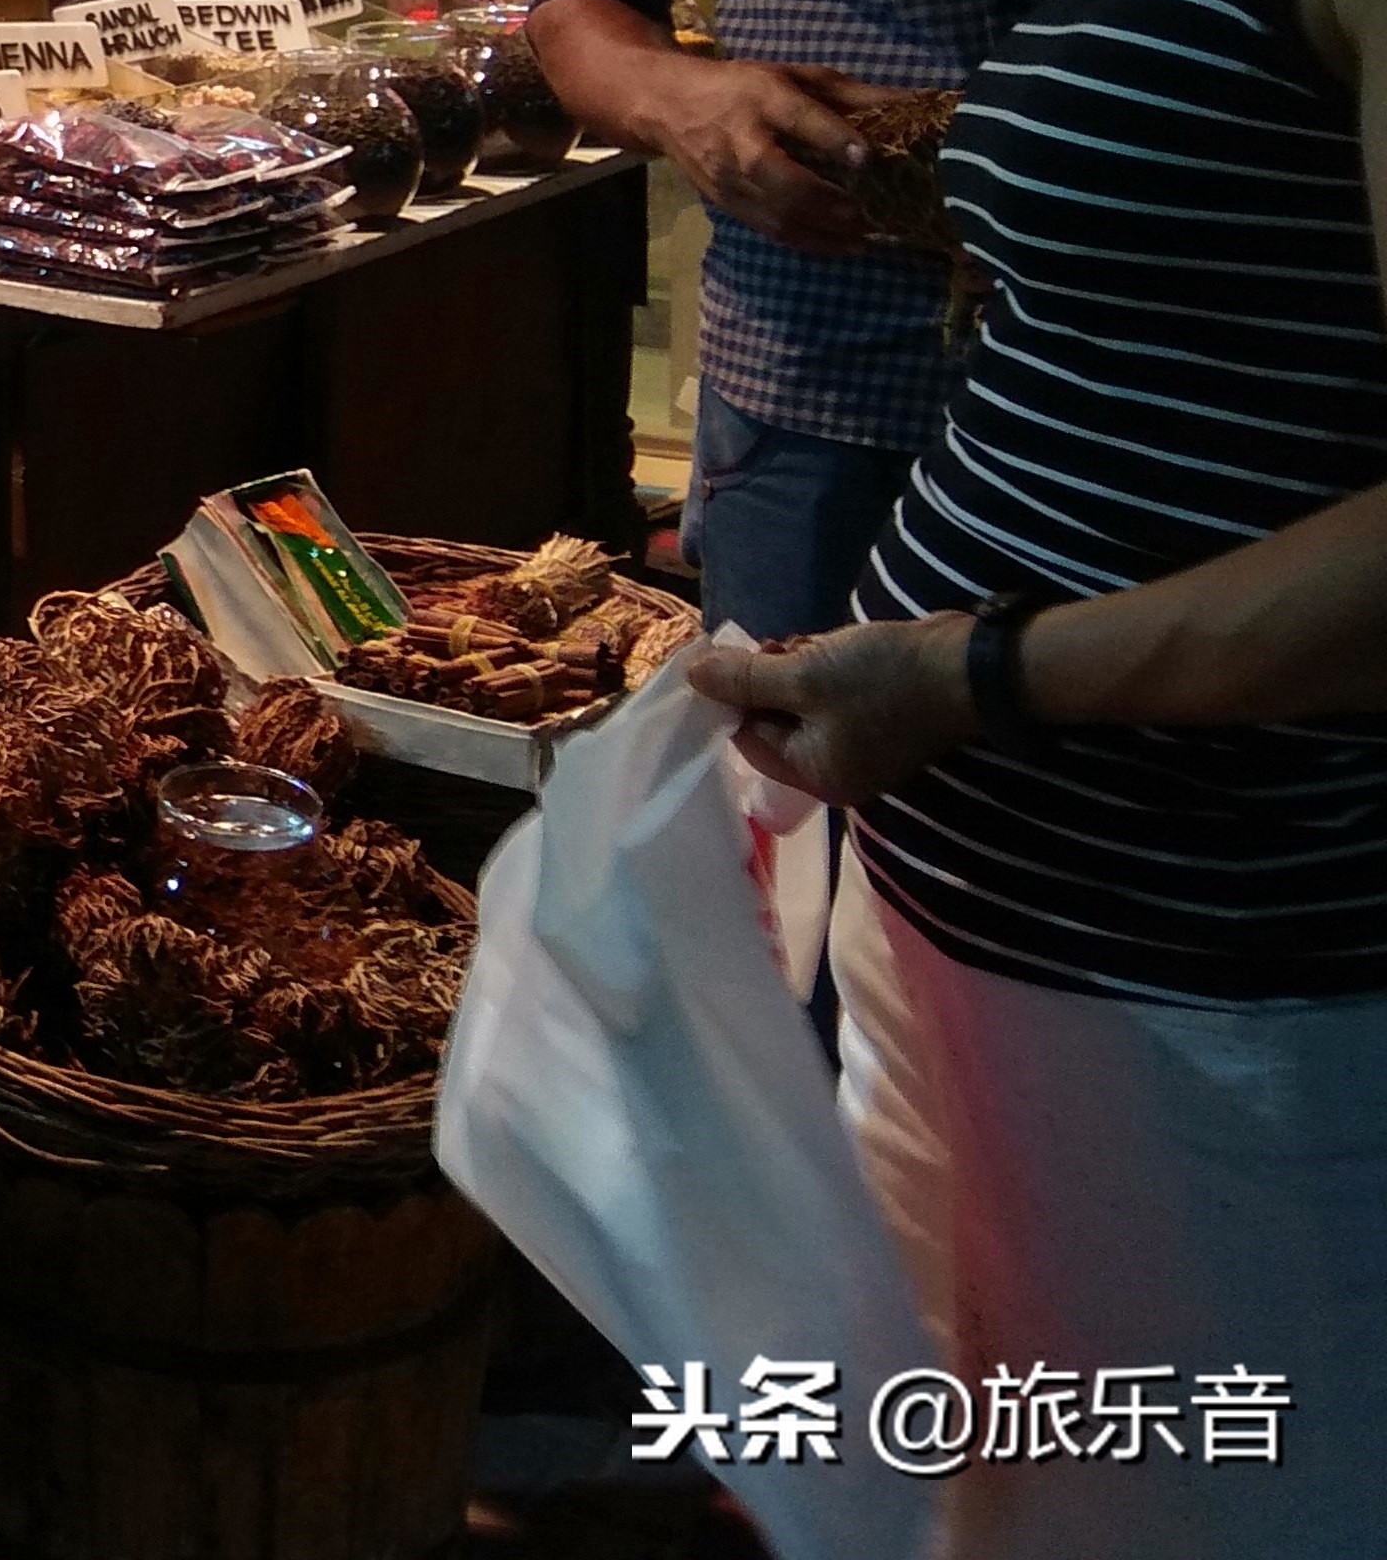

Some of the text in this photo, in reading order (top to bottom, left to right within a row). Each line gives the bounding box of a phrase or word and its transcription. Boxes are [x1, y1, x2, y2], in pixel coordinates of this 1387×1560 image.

[85, 1, 161, 31] SANDAL
[179, 4, 292, 27] BEDWIN
[213, 29, 278, 52] TEE
